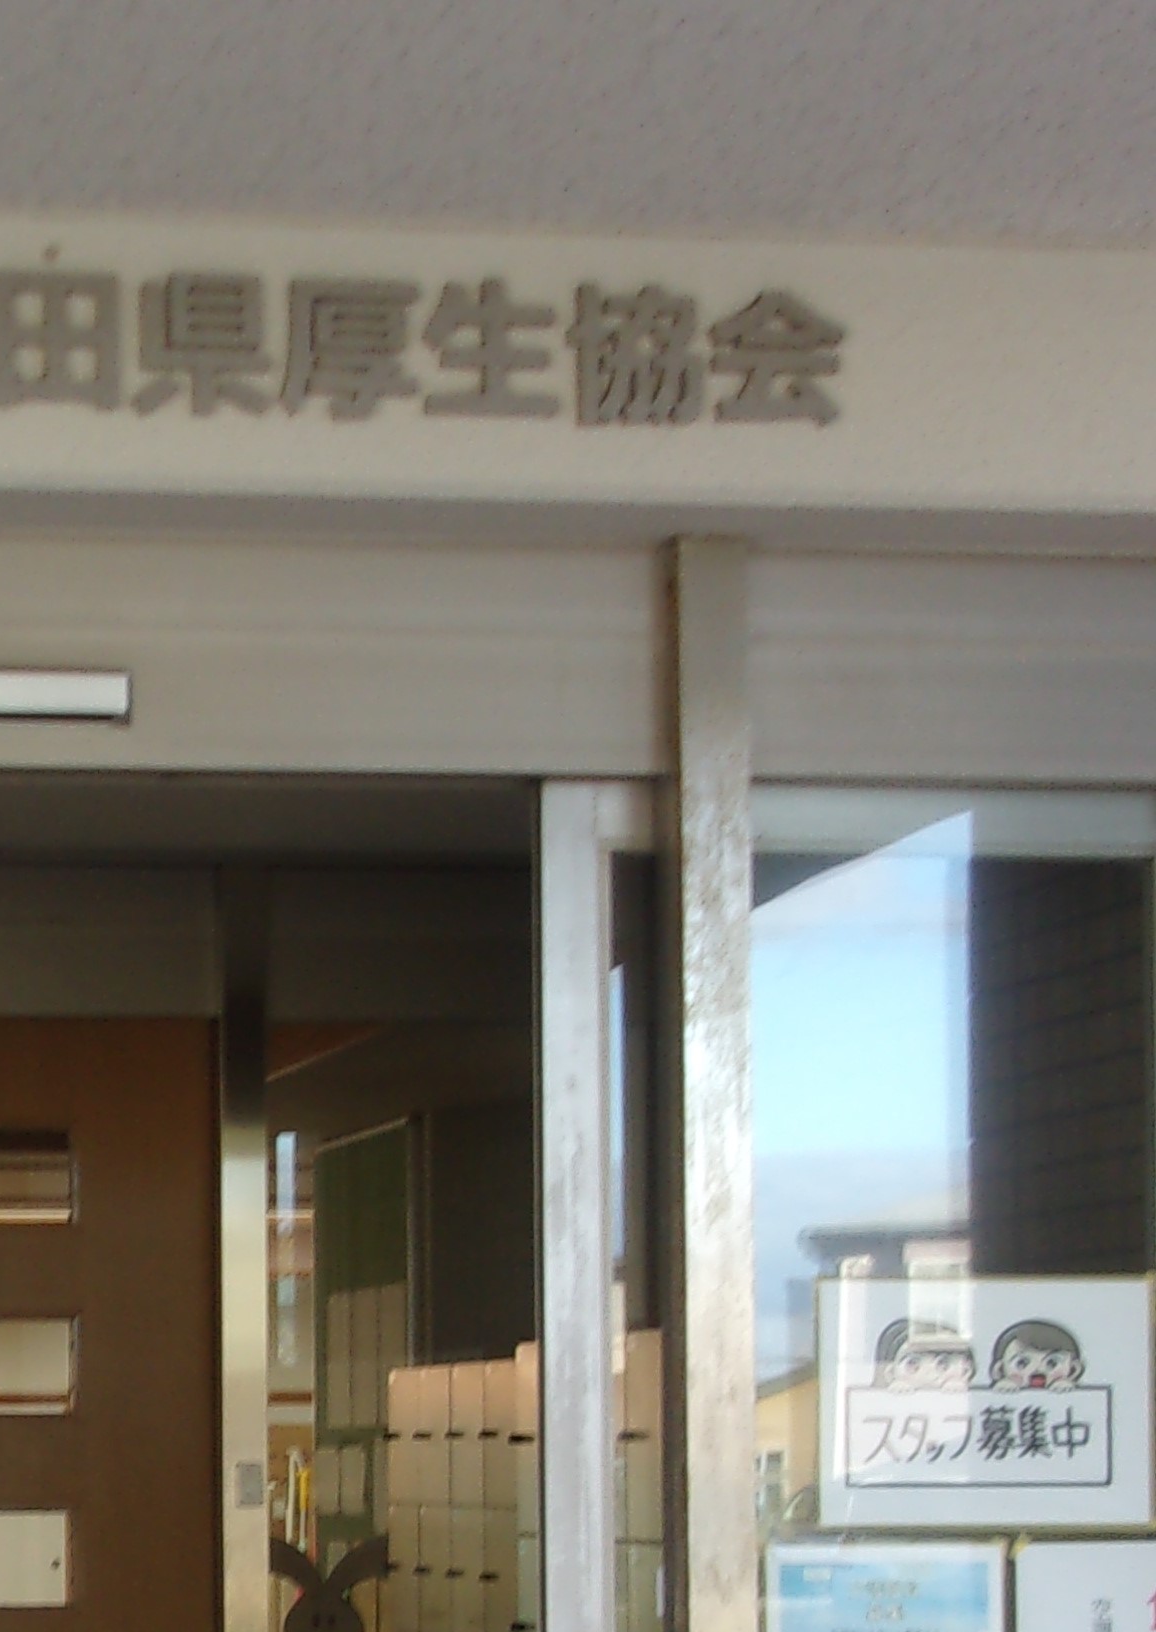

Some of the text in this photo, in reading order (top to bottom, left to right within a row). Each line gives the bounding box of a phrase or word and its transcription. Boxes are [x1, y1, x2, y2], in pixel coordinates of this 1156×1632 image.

[861, 1404, 1093, 1461] スタッフ募集中
